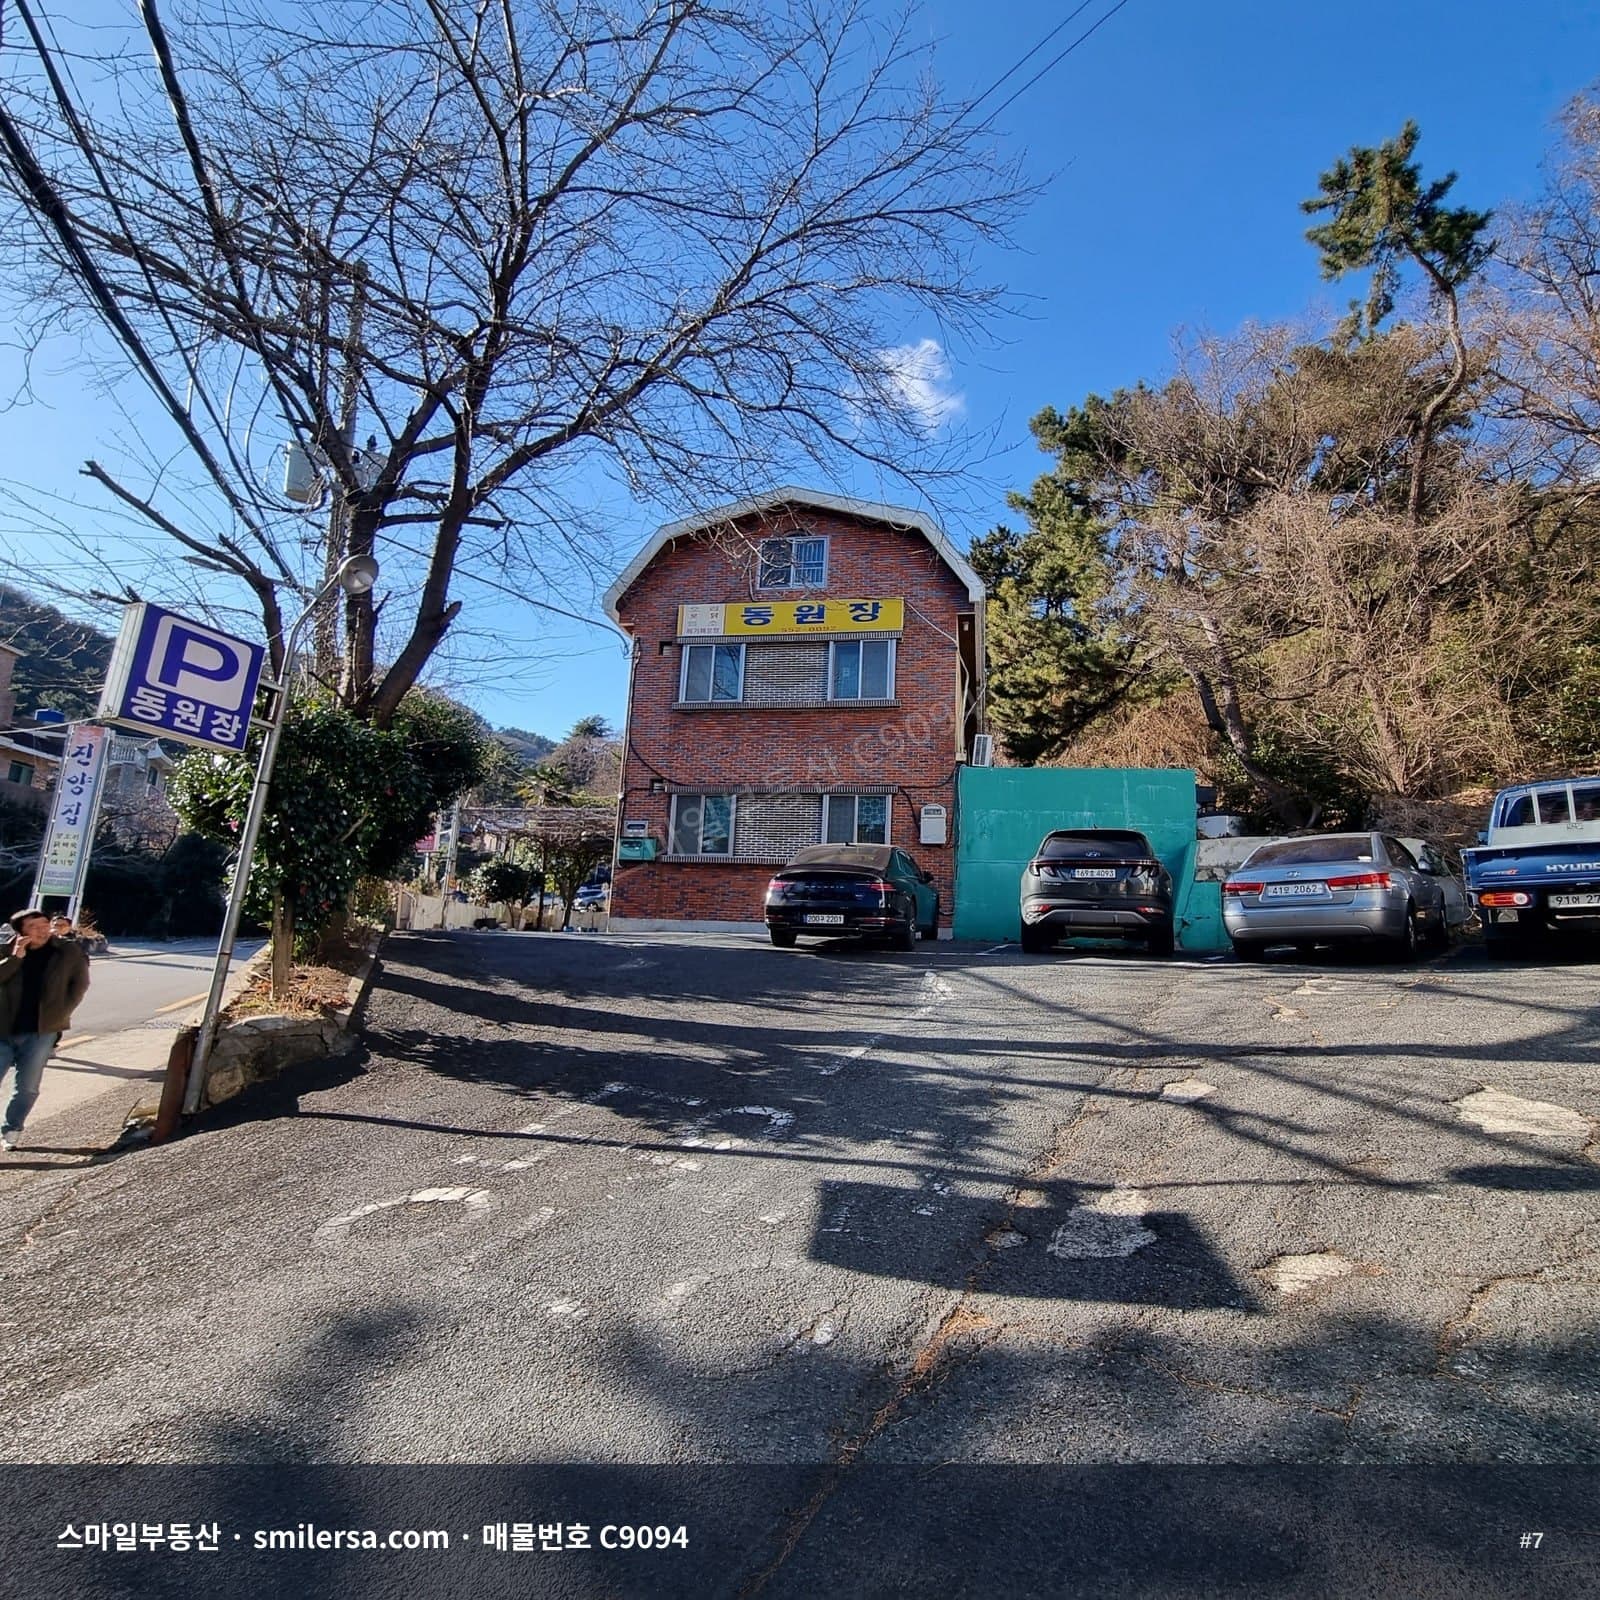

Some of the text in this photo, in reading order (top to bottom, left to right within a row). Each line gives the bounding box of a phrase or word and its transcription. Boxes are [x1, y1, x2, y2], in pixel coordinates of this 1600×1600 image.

[741, 601, 883, 626] 동원장
[158, 624, 239, 688] P
[130, 686, 243, 743] 동원장
[60, 742, 94, 827] 진양집
[1294, 884, 1318, 894] 2062
